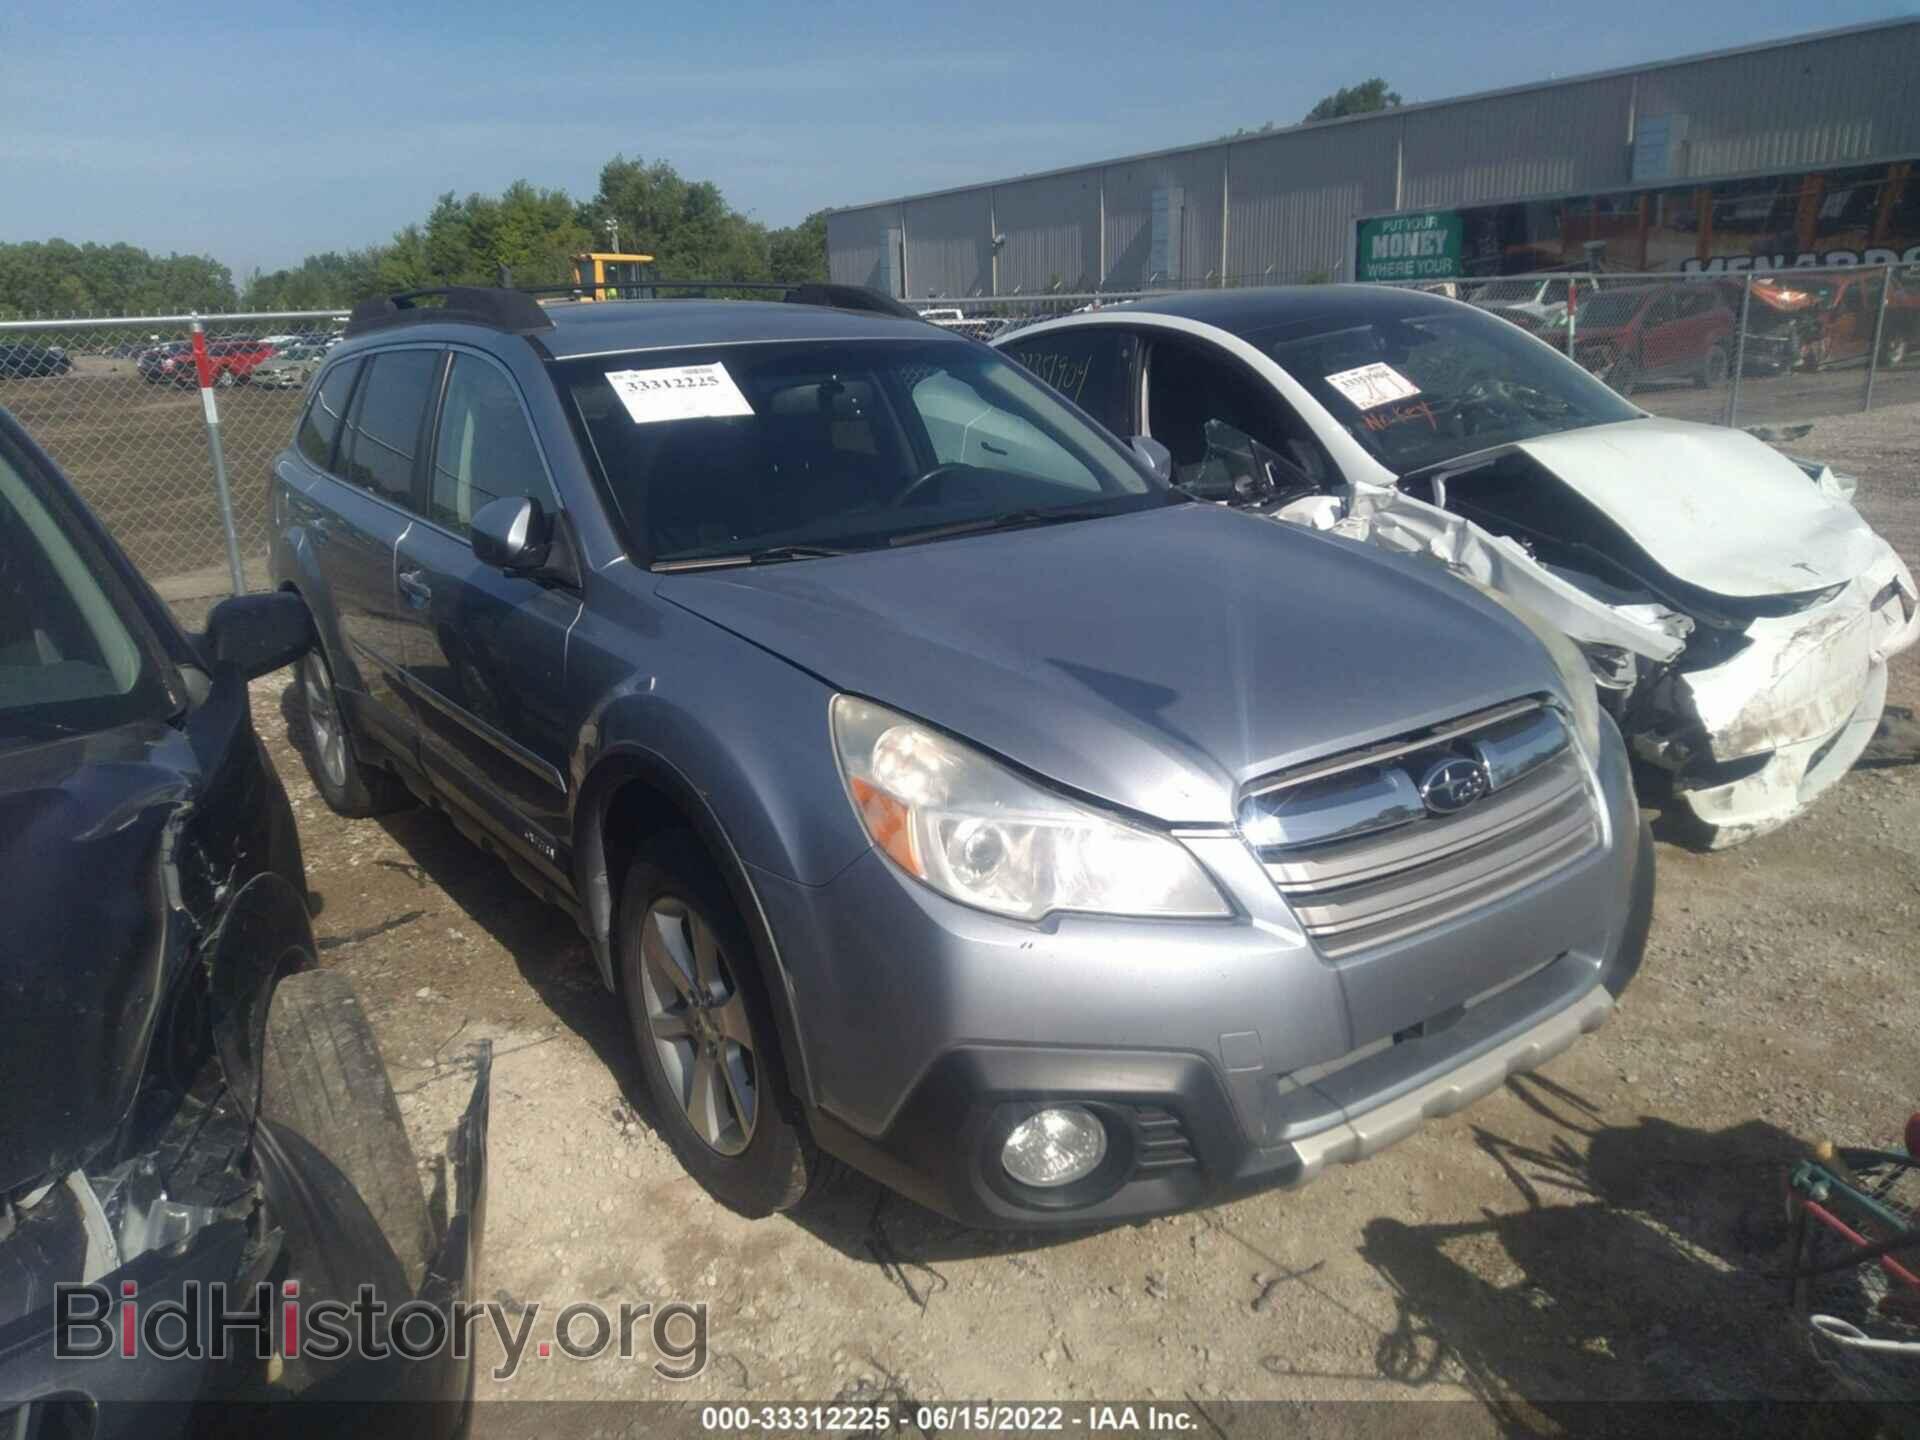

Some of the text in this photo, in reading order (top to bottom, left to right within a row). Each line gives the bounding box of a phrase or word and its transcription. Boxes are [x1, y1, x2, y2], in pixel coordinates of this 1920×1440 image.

[1383, 215, 1438, 233] PUT YOUR
[1372, 230, 1448, 259] MONEY
[1367, 257, 1453, 277] WHERE YOUR
[625, 375, 720, 392] 33312225
